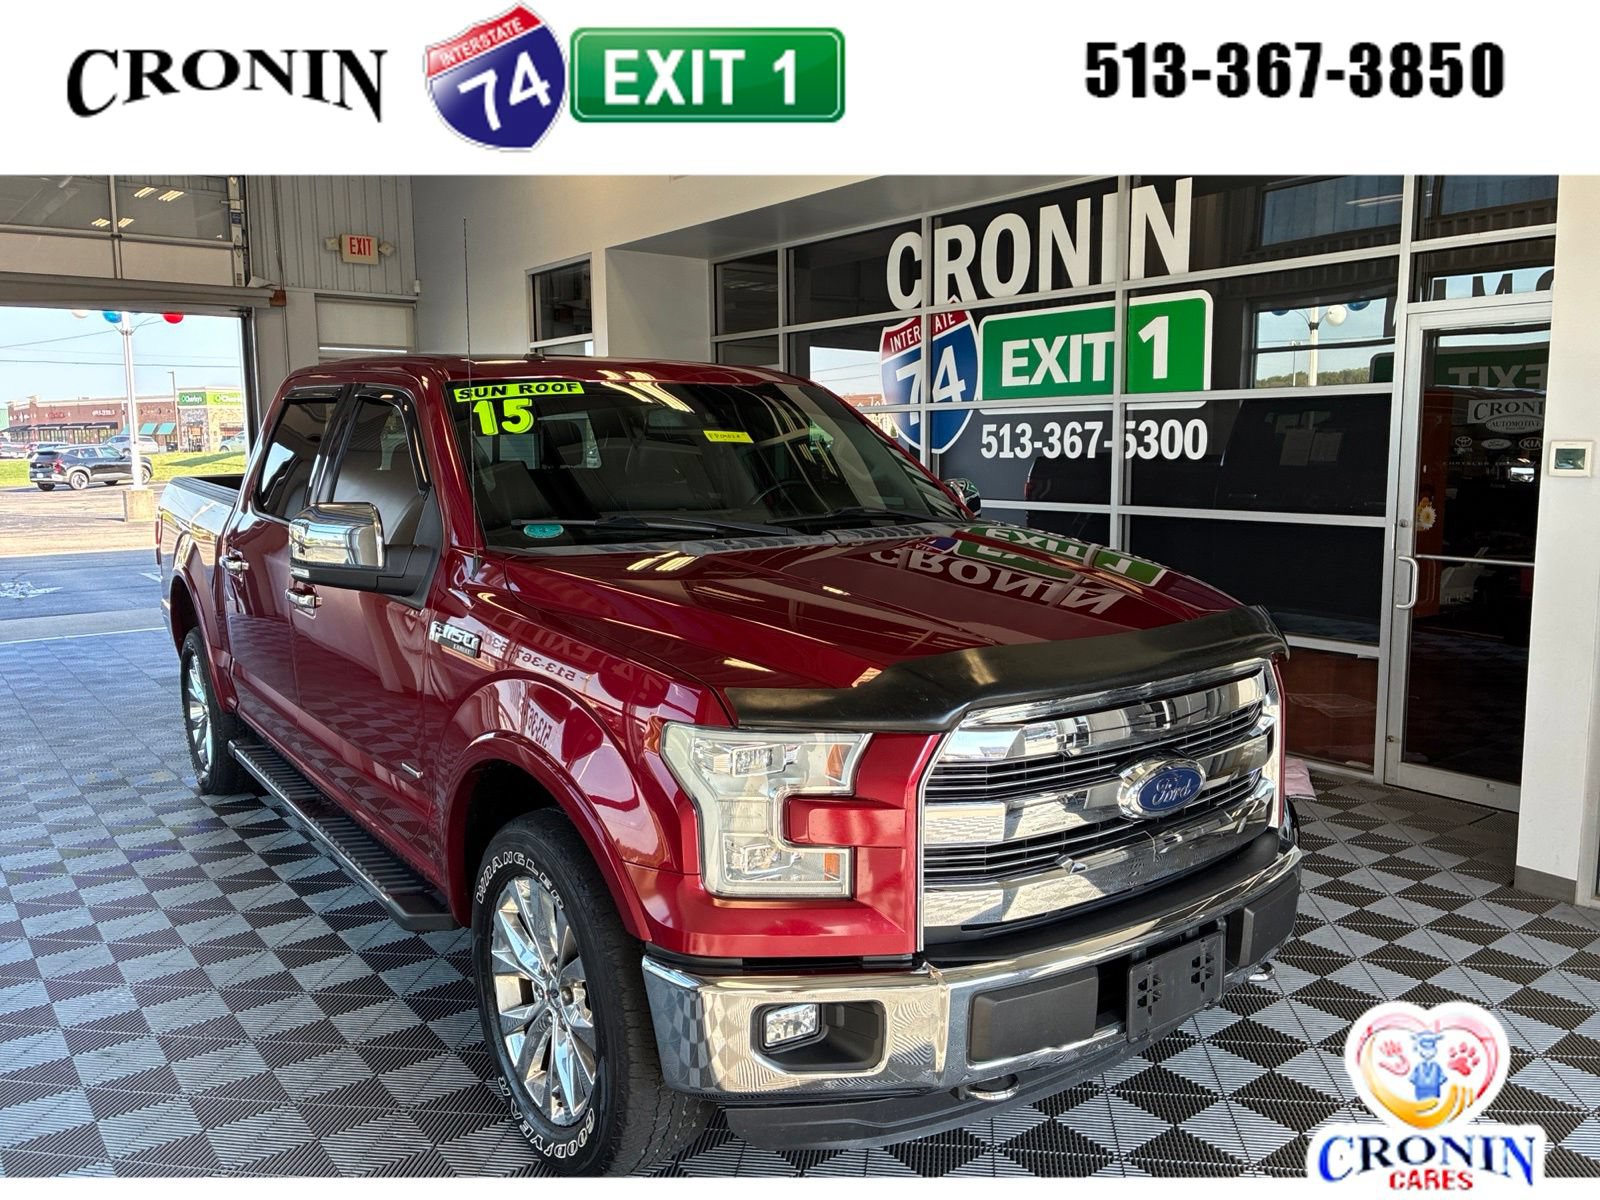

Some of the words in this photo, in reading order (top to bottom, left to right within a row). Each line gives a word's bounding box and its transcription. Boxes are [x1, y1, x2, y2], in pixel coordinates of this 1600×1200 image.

[349, 236, 372, 256] EXIT
[886, 177, 1193, 311] CRONIN
[889, 312, 956, 353] INTERATE
[1001, 331, 1116, 387] EXIT
[1138, 315, 1169, 379] 1
[458, 386, 508, 400] SUN
[520, 382, 579, 395] ROOF
[896, 345, 966, 426] 74
[473, 398, 535, 436] 15
[1473, 400, 1545, 421] CRONI
[981, 418, 1208, 460] 513-367-5300
[1152, 778, 1192, 806] Ford
[476, 851, 564, 910] WRANGLER
[498, 1077, 595, 1159] GOODYEAR
